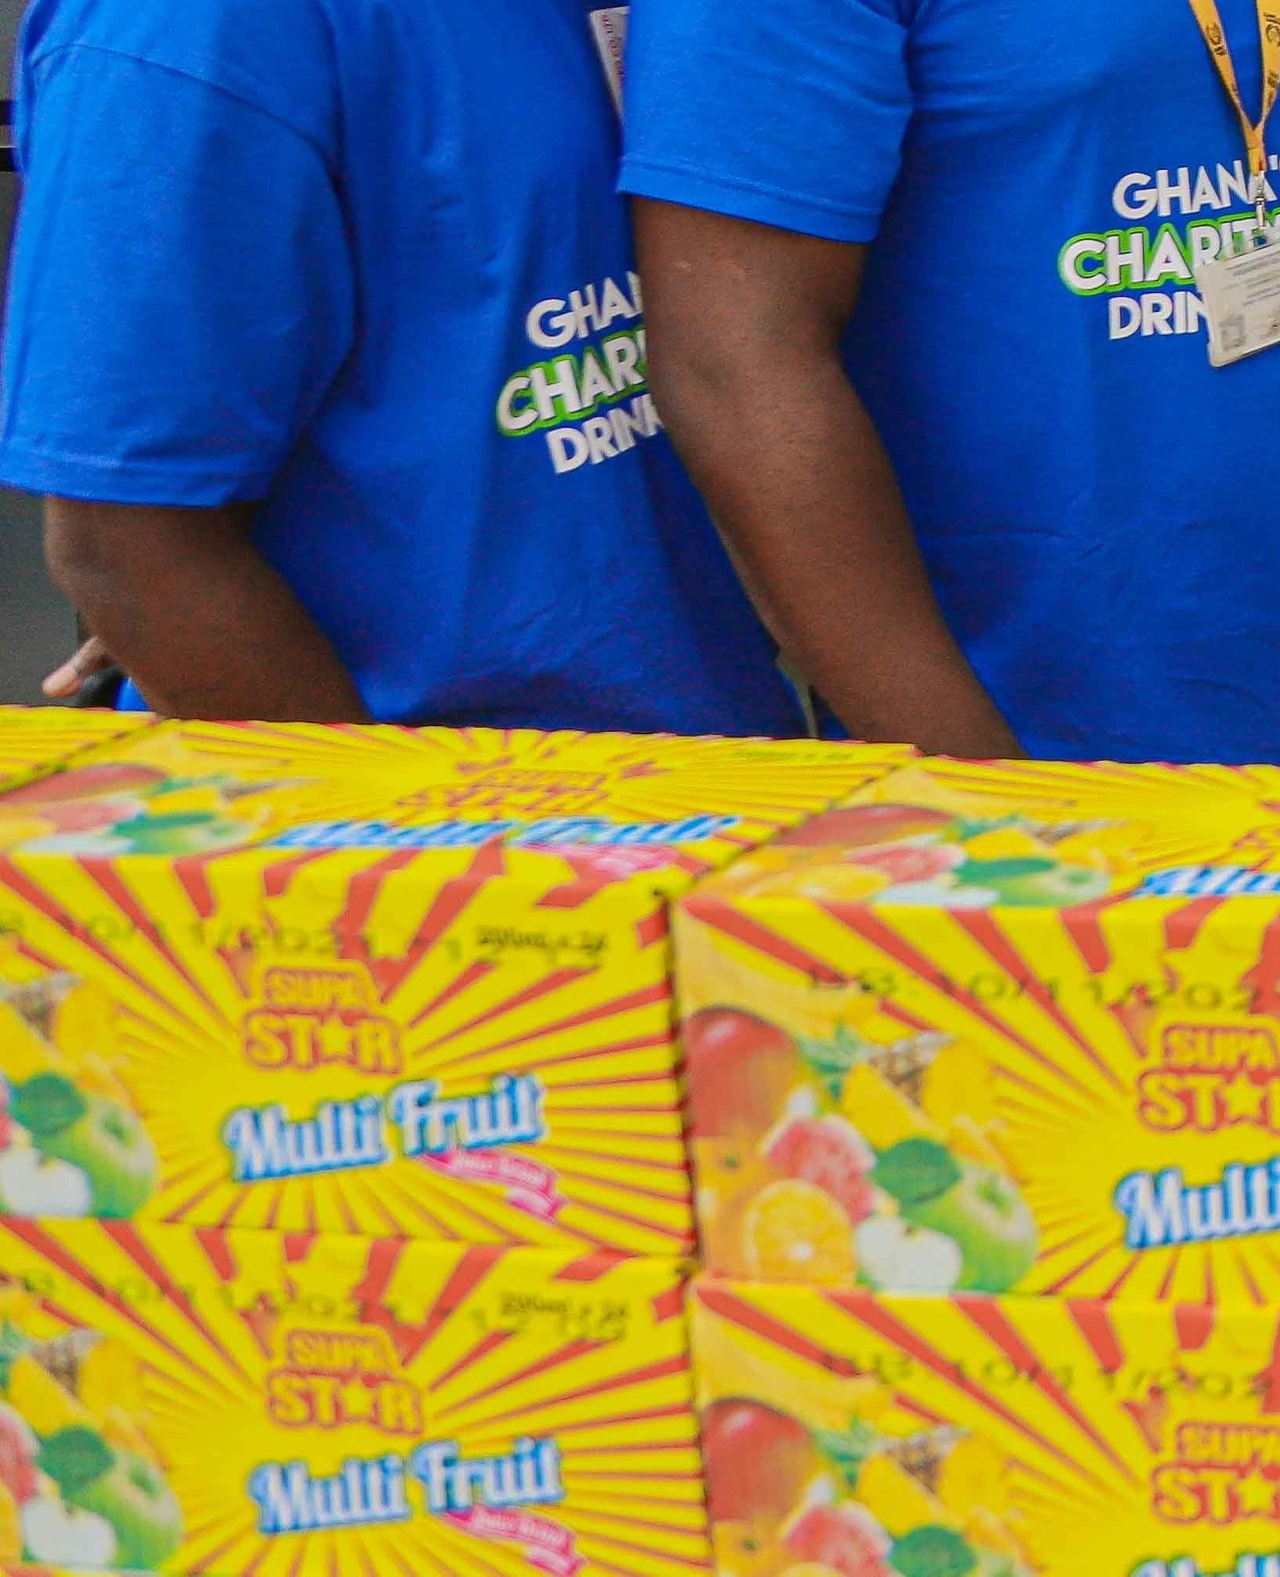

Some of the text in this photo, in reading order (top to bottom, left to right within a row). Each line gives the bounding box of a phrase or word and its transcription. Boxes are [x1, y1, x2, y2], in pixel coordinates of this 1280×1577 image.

[266, 964, 374, 1007] SUPA
[224, 1096, 391, 1183] Multi
[390, 1074, 548, 1157] Fruit
[286, 1329, 392, 1372] SUPA
[250, 1458, 409, 1536] Multi
[408, 1437, 566, 1514] Fruit
